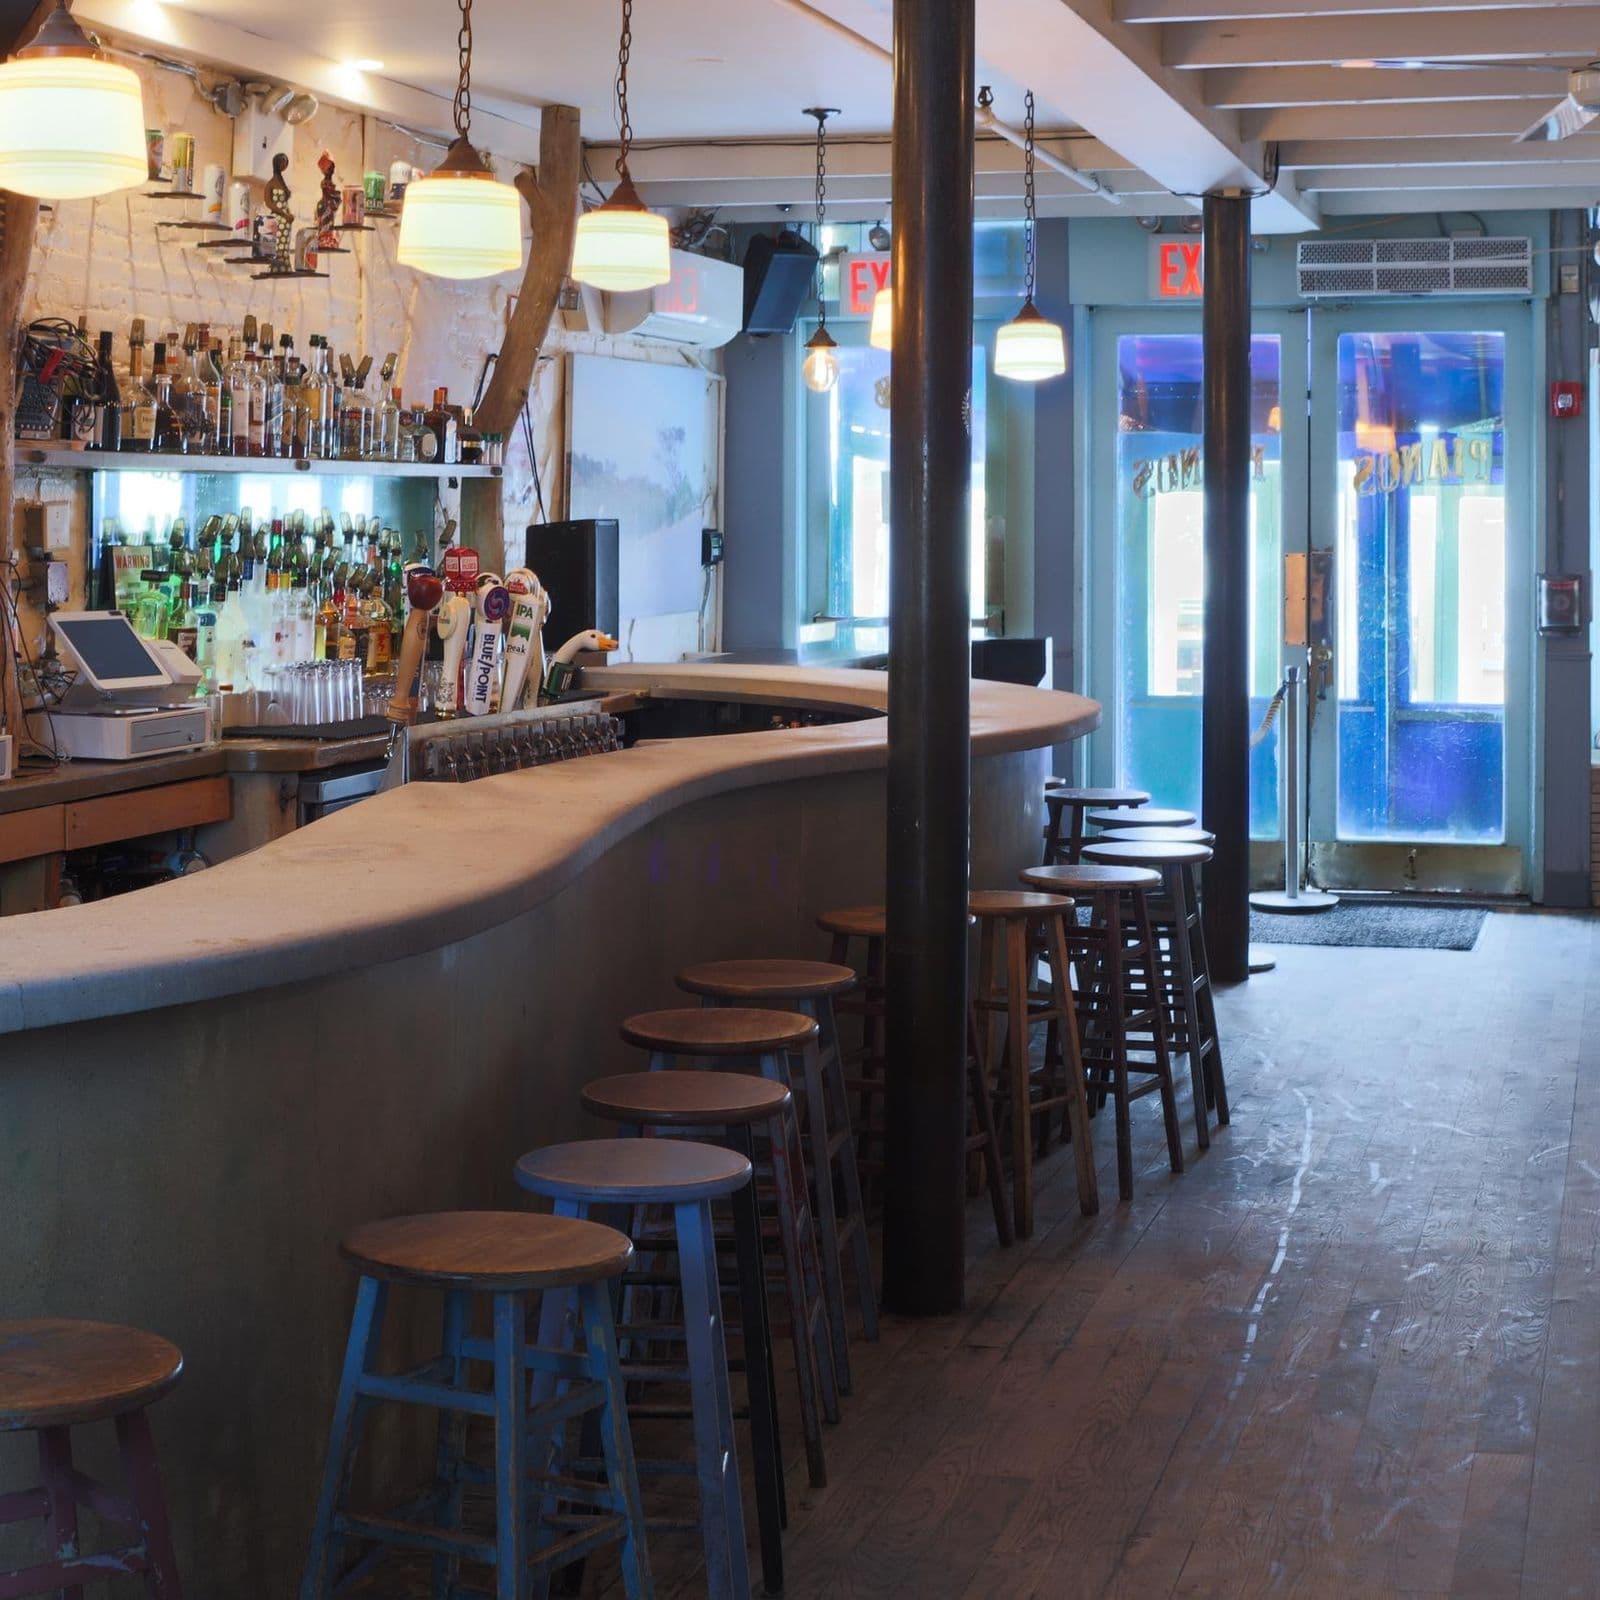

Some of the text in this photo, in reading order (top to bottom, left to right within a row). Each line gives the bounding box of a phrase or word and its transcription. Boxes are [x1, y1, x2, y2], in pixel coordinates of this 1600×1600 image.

[1160, 243, 1203, 296] EX
[850, 261, 889, 314] EX
[115, 554, 150, 569] WARNING
[516, 603, 534, 619] IPA
